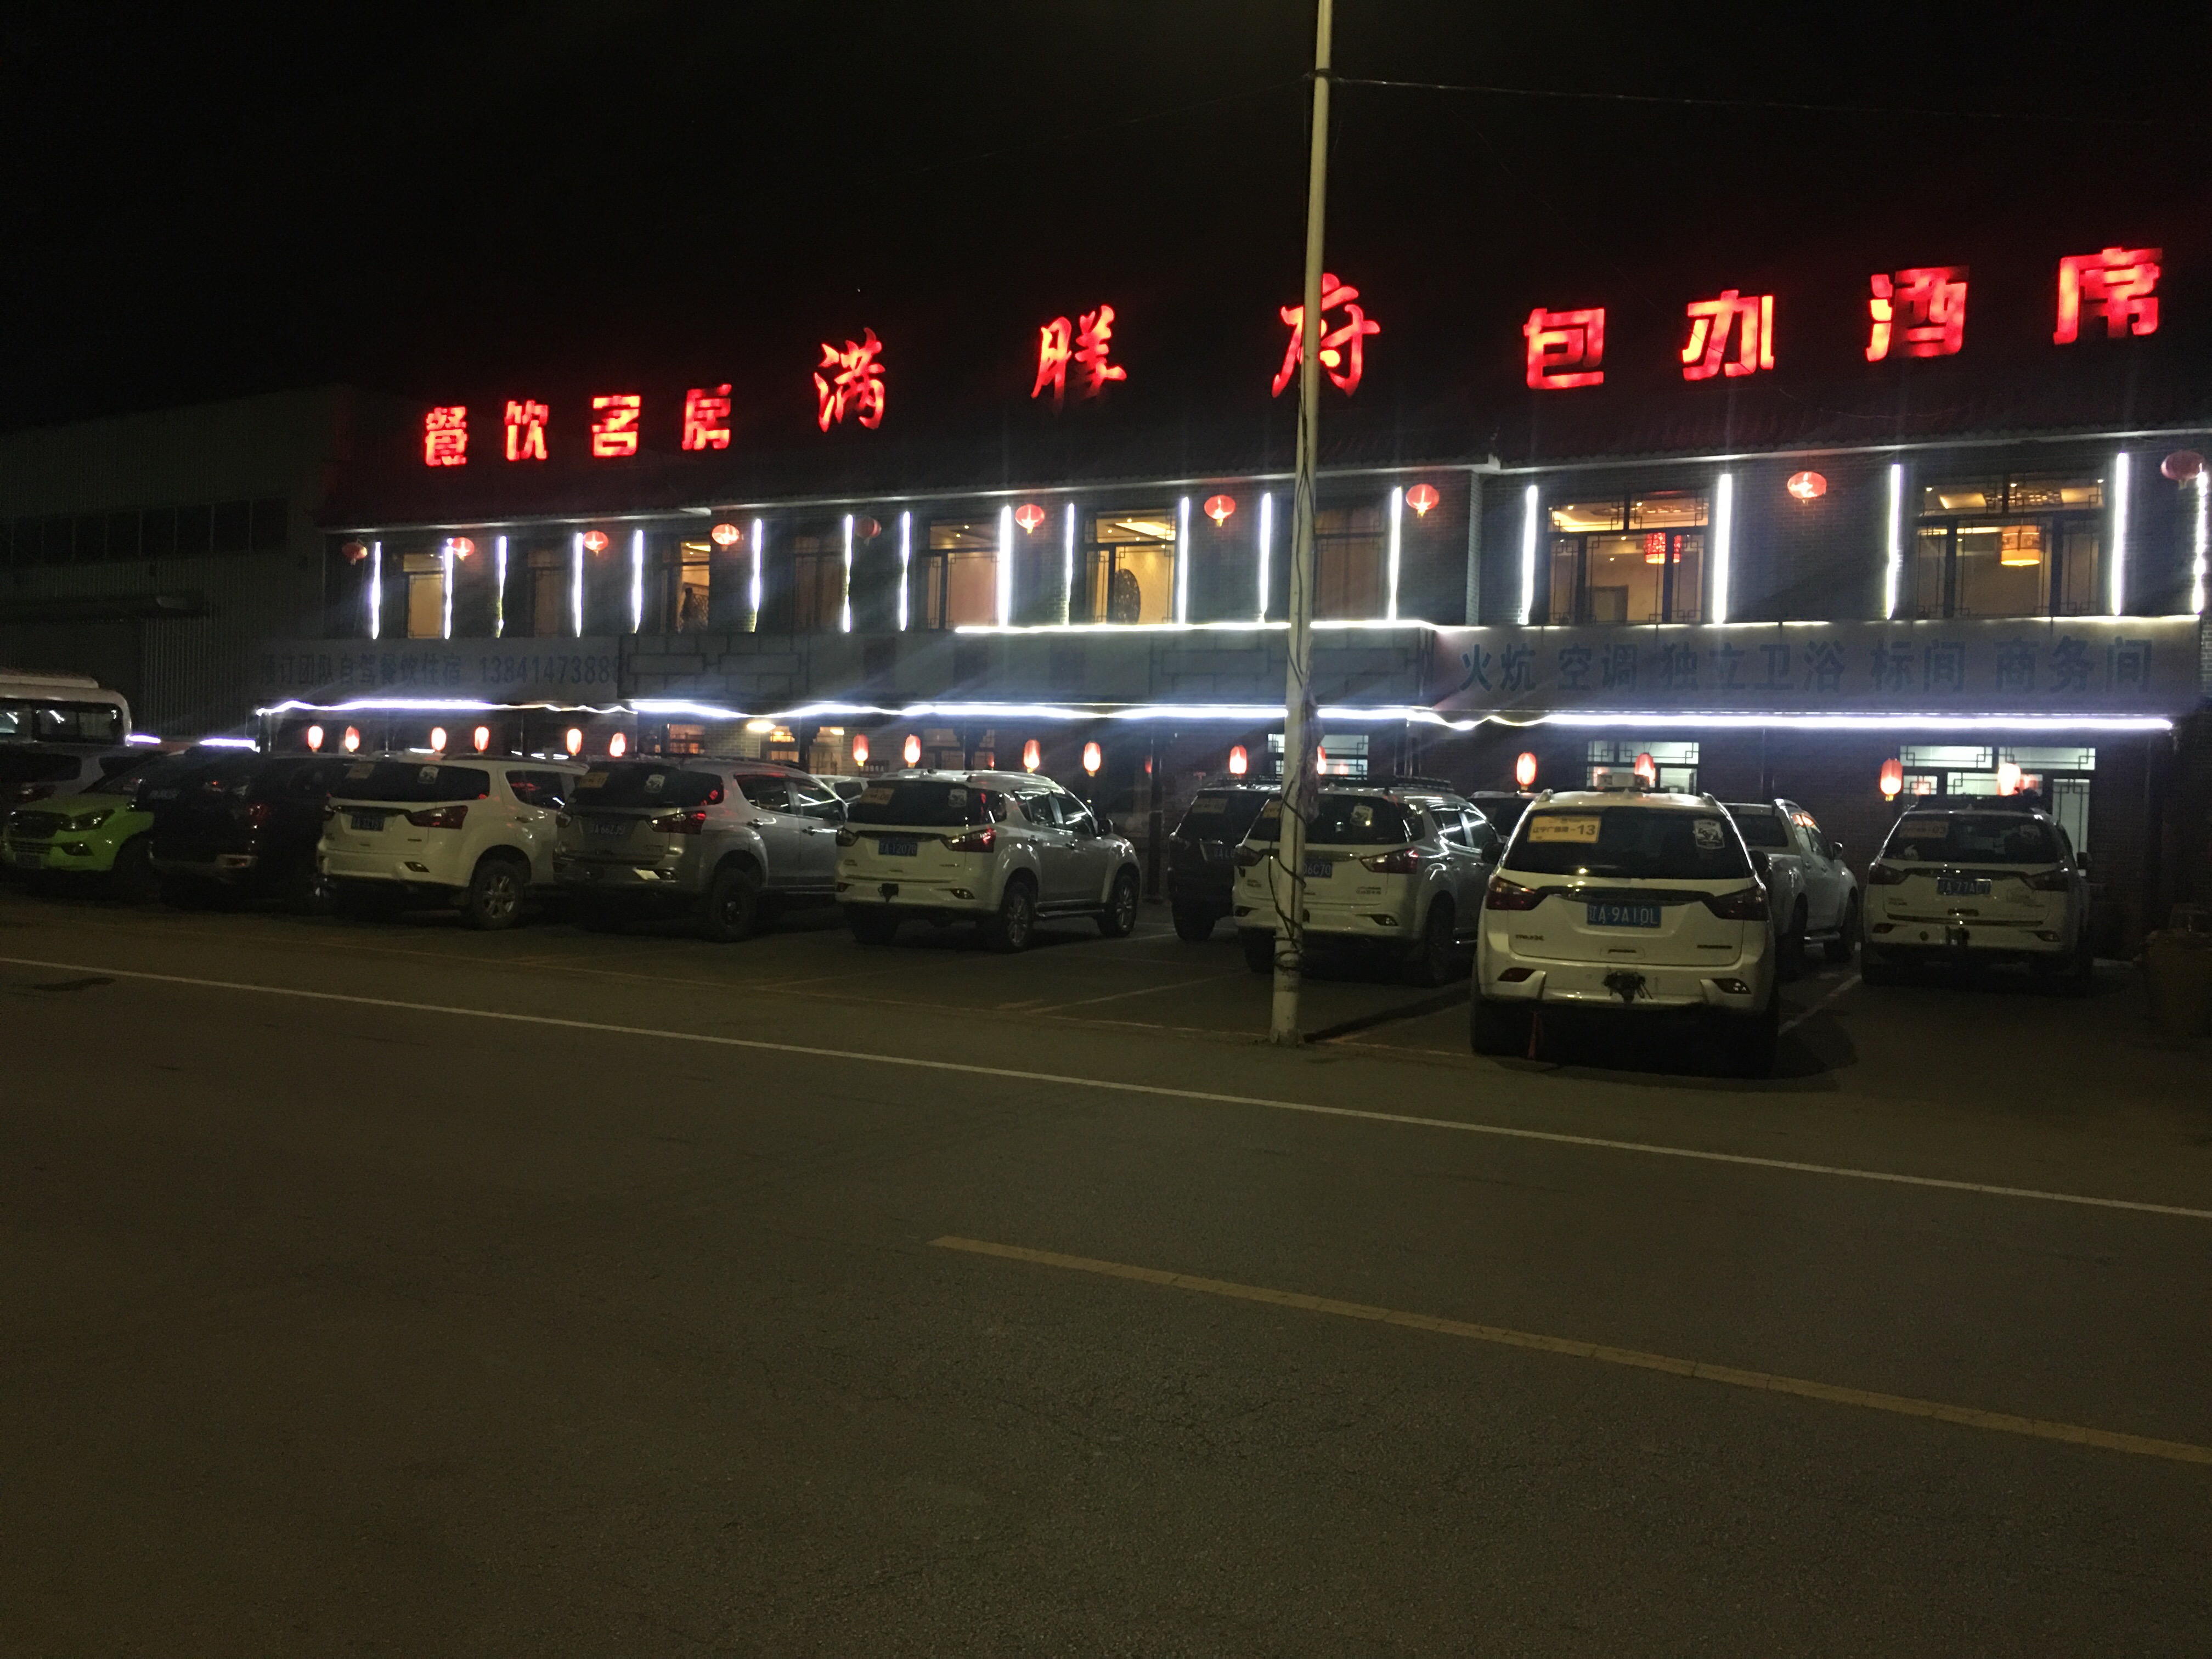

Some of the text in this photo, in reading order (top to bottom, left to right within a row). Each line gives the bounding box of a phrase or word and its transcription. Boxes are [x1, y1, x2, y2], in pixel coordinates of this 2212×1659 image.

[422, 383, 732, 467] 餐饮客房
[1522, 247, 2163, 390] 包办酒席
[1459, 636, 2154, 693] 火炕 空调 独立卫浴 标间 商务间
